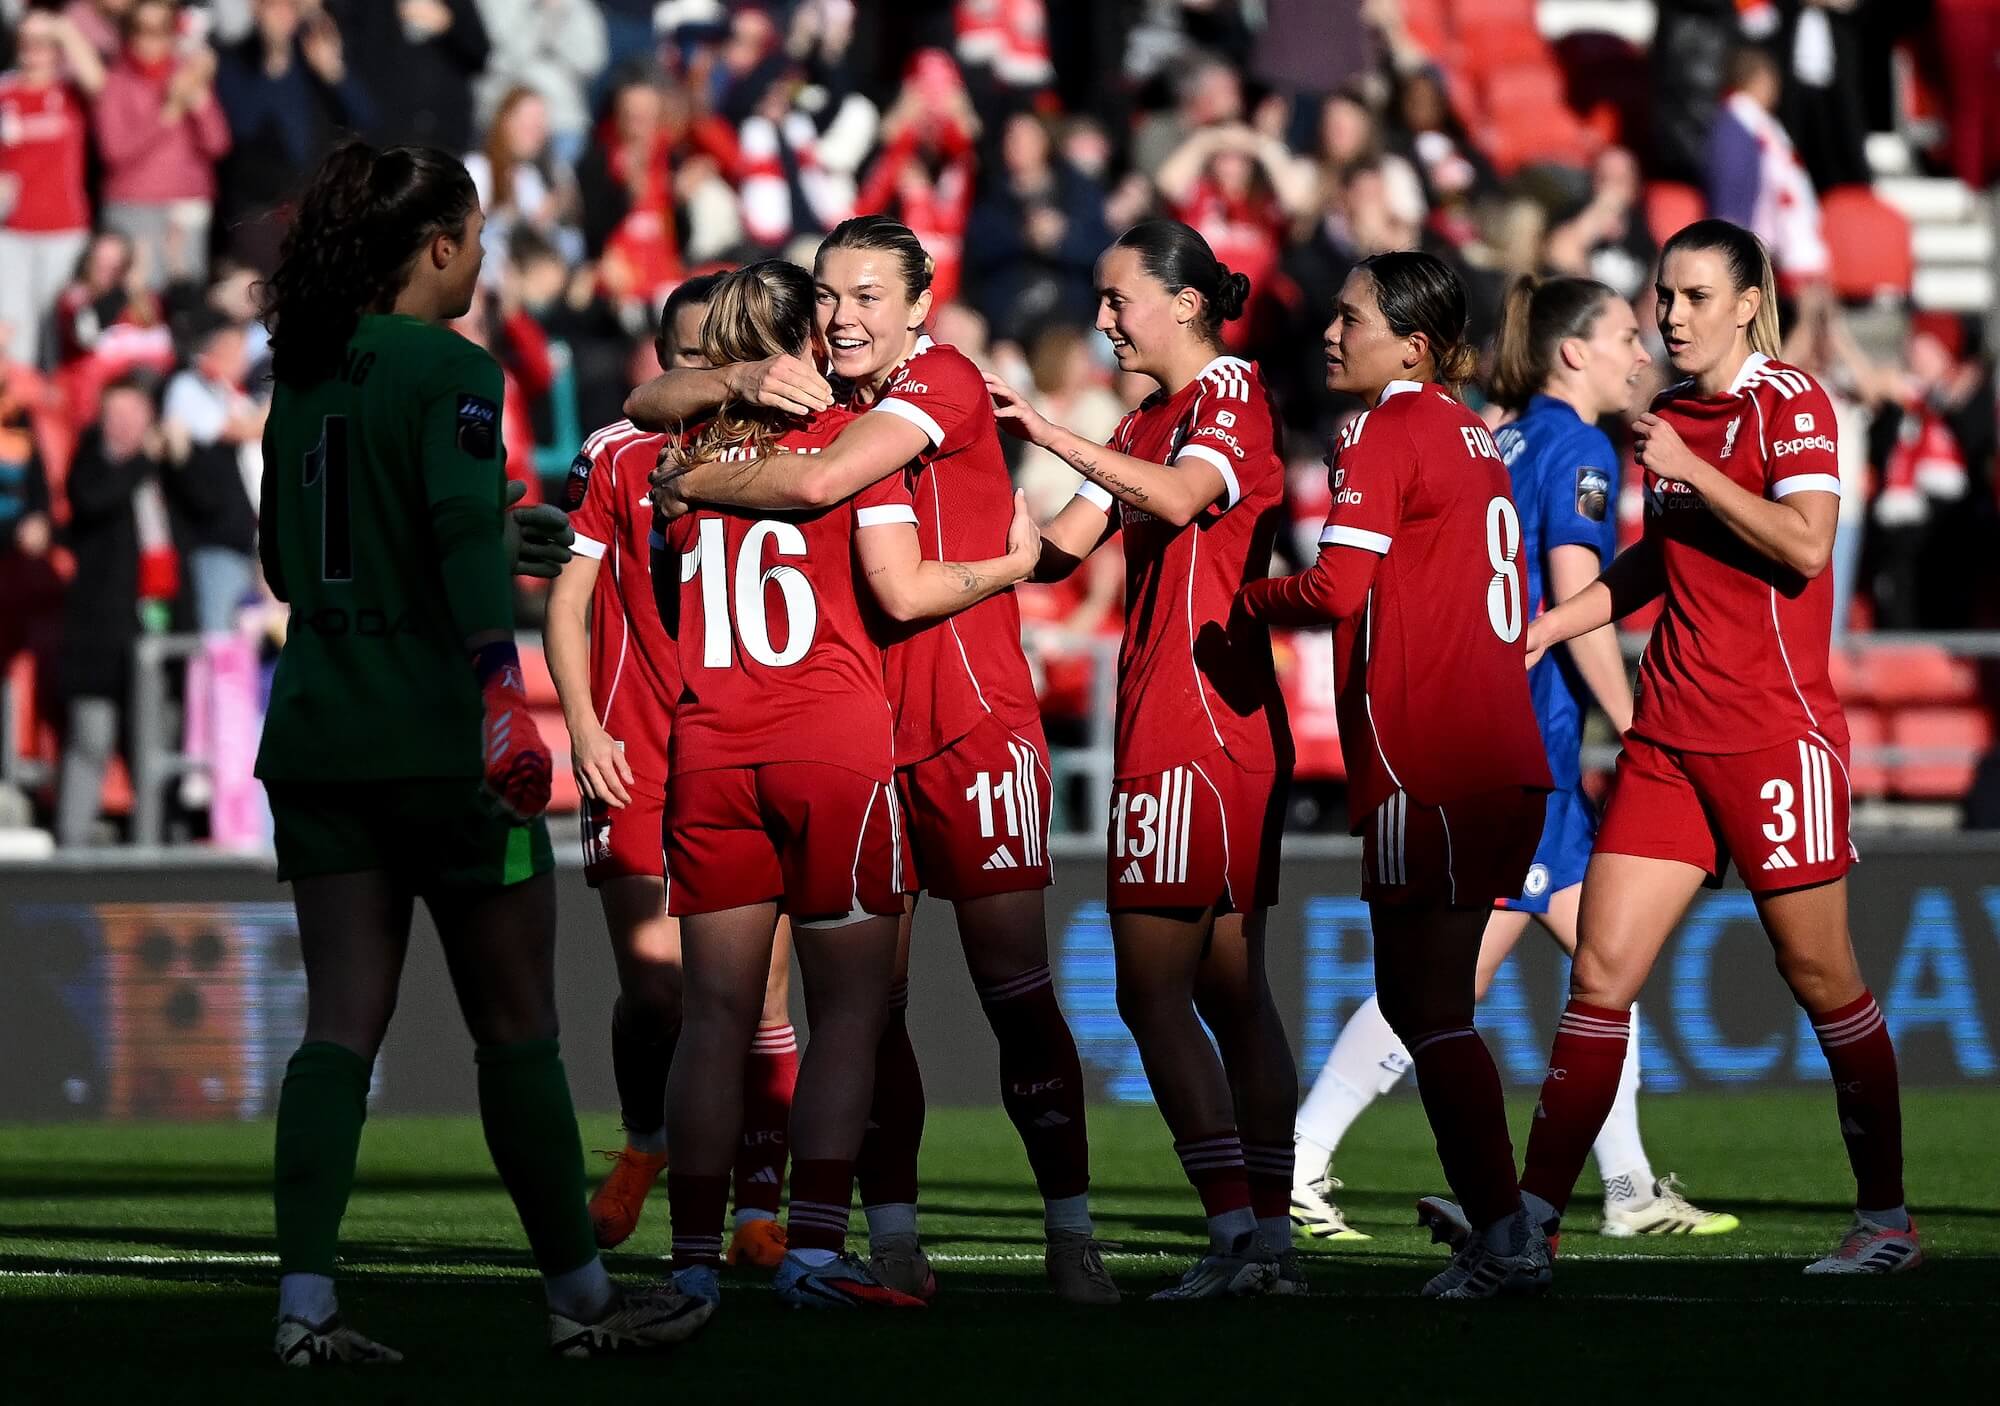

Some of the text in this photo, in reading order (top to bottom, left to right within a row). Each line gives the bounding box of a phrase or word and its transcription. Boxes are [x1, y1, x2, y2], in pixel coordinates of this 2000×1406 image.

[1193, 426, 1245, 459] xpedia
[1773, 434, 1835, 458] Expedia
[302, 414, 353, 583] 1
[680, 516, 818, 669] 16
[1485, 496, 1523, 643] 8
[966, 771, 1020, 838] 11
[1112, 793, 1159, 858] 13
[1760, 778, 1797, 843] 3
[1013, 1077, 1065, 1096] LFC
